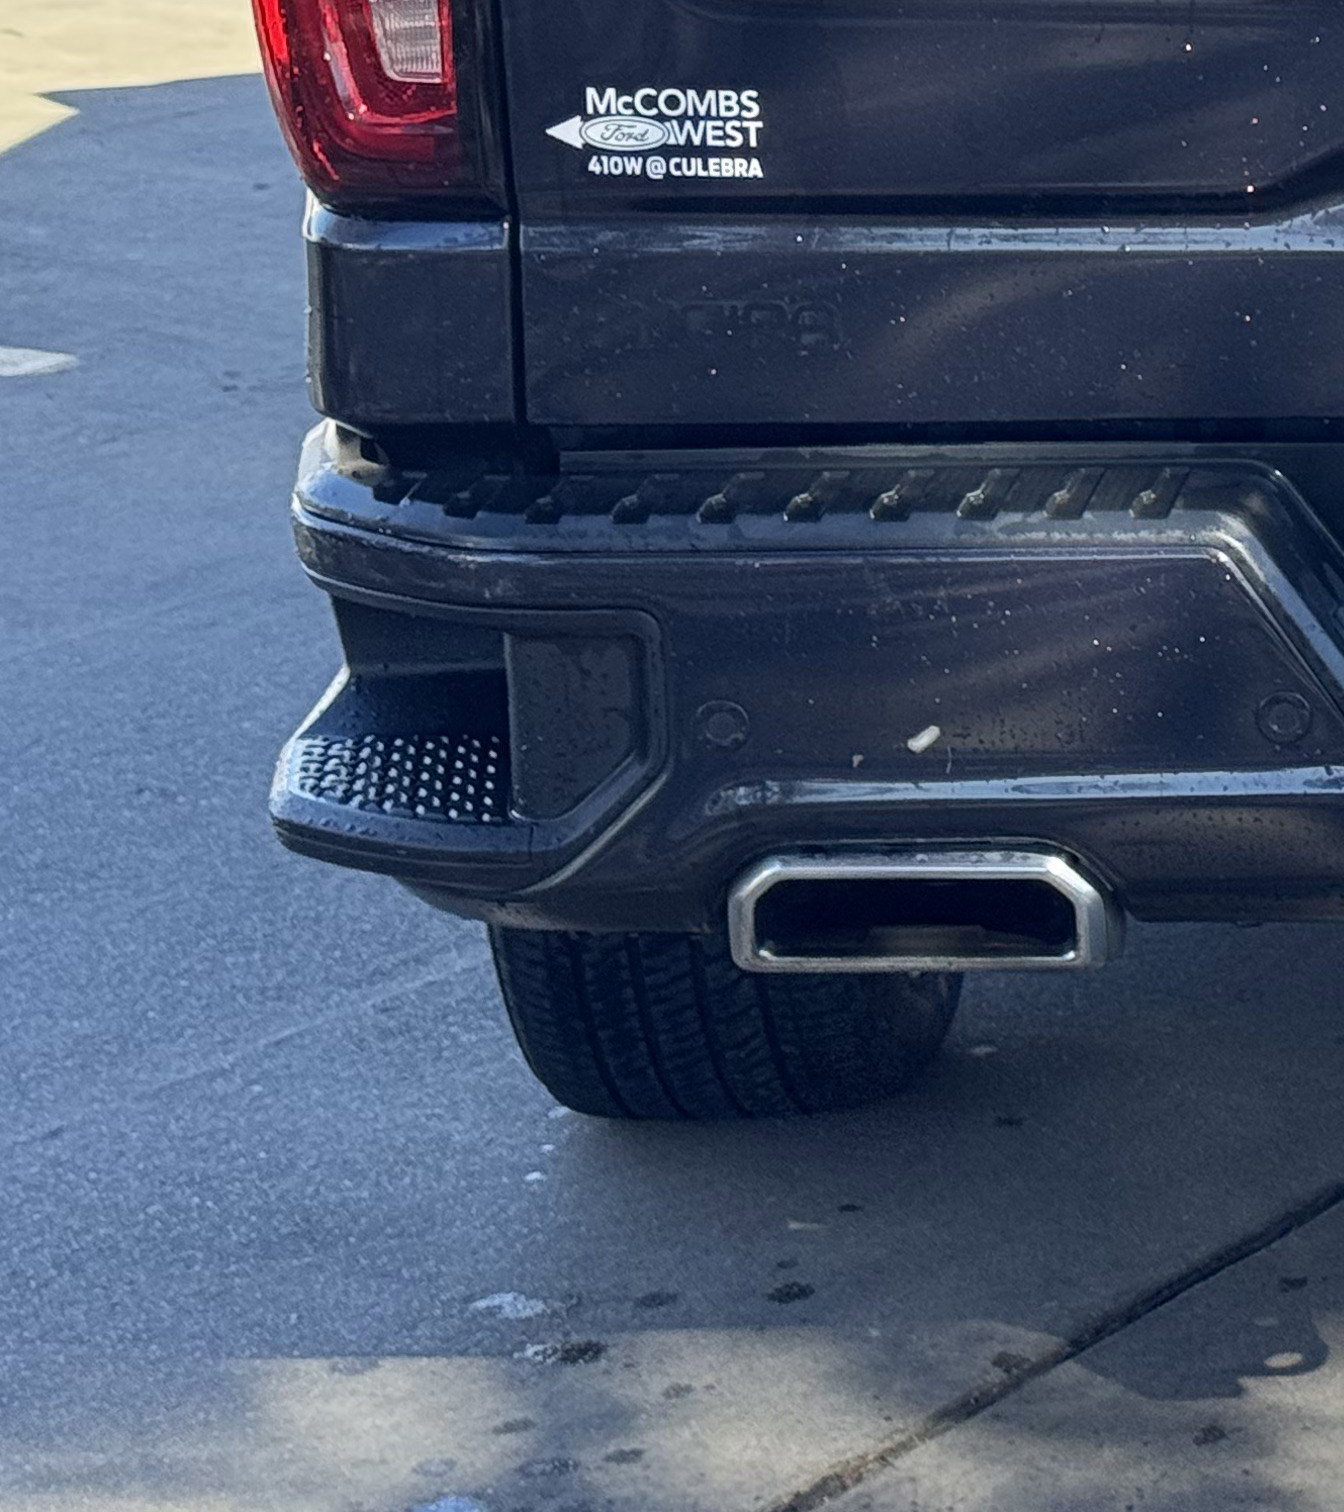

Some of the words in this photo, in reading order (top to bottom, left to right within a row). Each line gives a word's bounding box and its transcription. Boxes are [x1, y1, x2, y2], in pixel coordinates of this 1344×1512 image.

[585, 86, 760, 119] McCOMBS
[600, 123, 650, 143] Ford
[672, 119, 764, 148] WEST
[588, 155, 643, 176] 410W
[646, 155, 667, 179] @
[669, 157, 764, 178] CULEBRA
